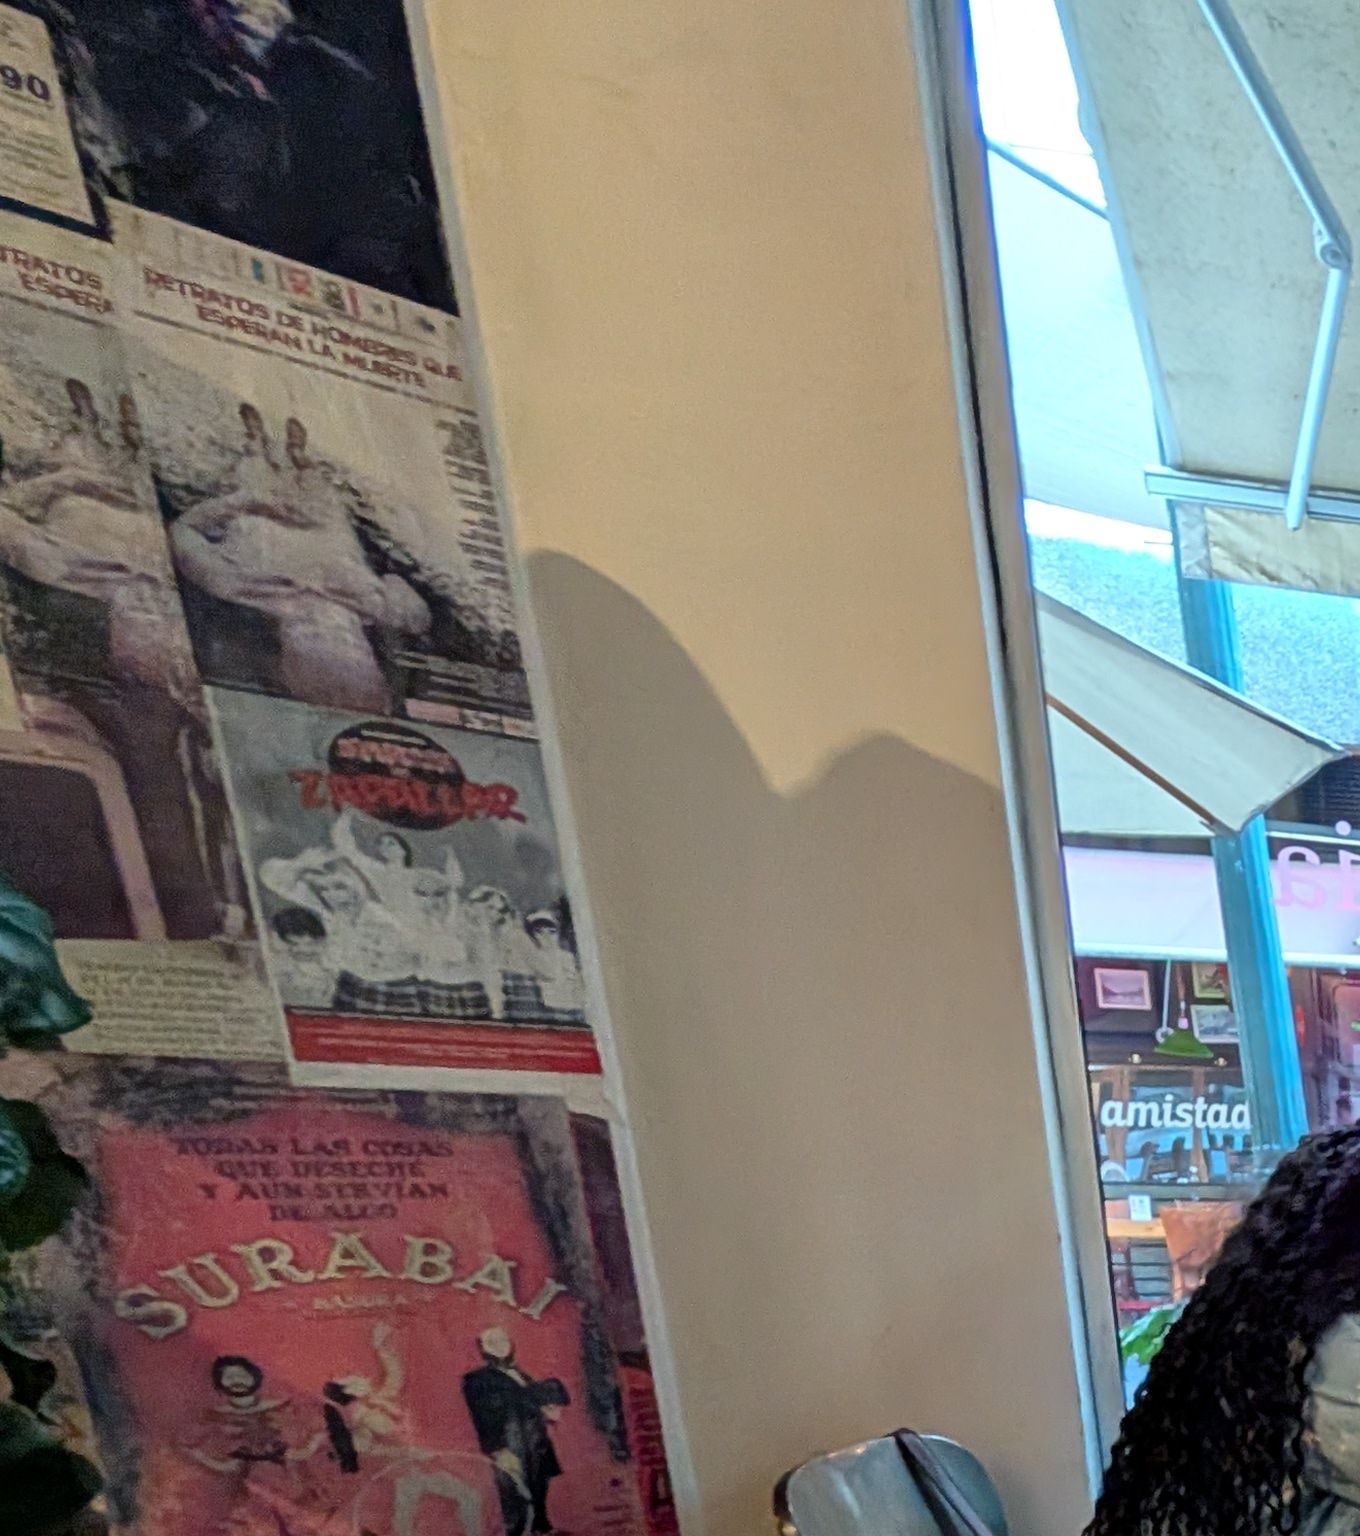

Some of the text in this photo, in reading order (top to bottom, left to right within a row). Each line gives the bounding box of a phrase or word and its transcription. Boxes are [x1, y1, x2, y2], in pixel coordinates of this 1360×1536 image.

[143, 265, 269, 319] RETRATOS
[276, 309, 305, 331] DE
[196, 304, 301, 351] ESPERAN
[307, 338, 337, 361] LA
[290, 1137, 351, 1156] LAS
[362, 1138, 455, 1158] COSAS
